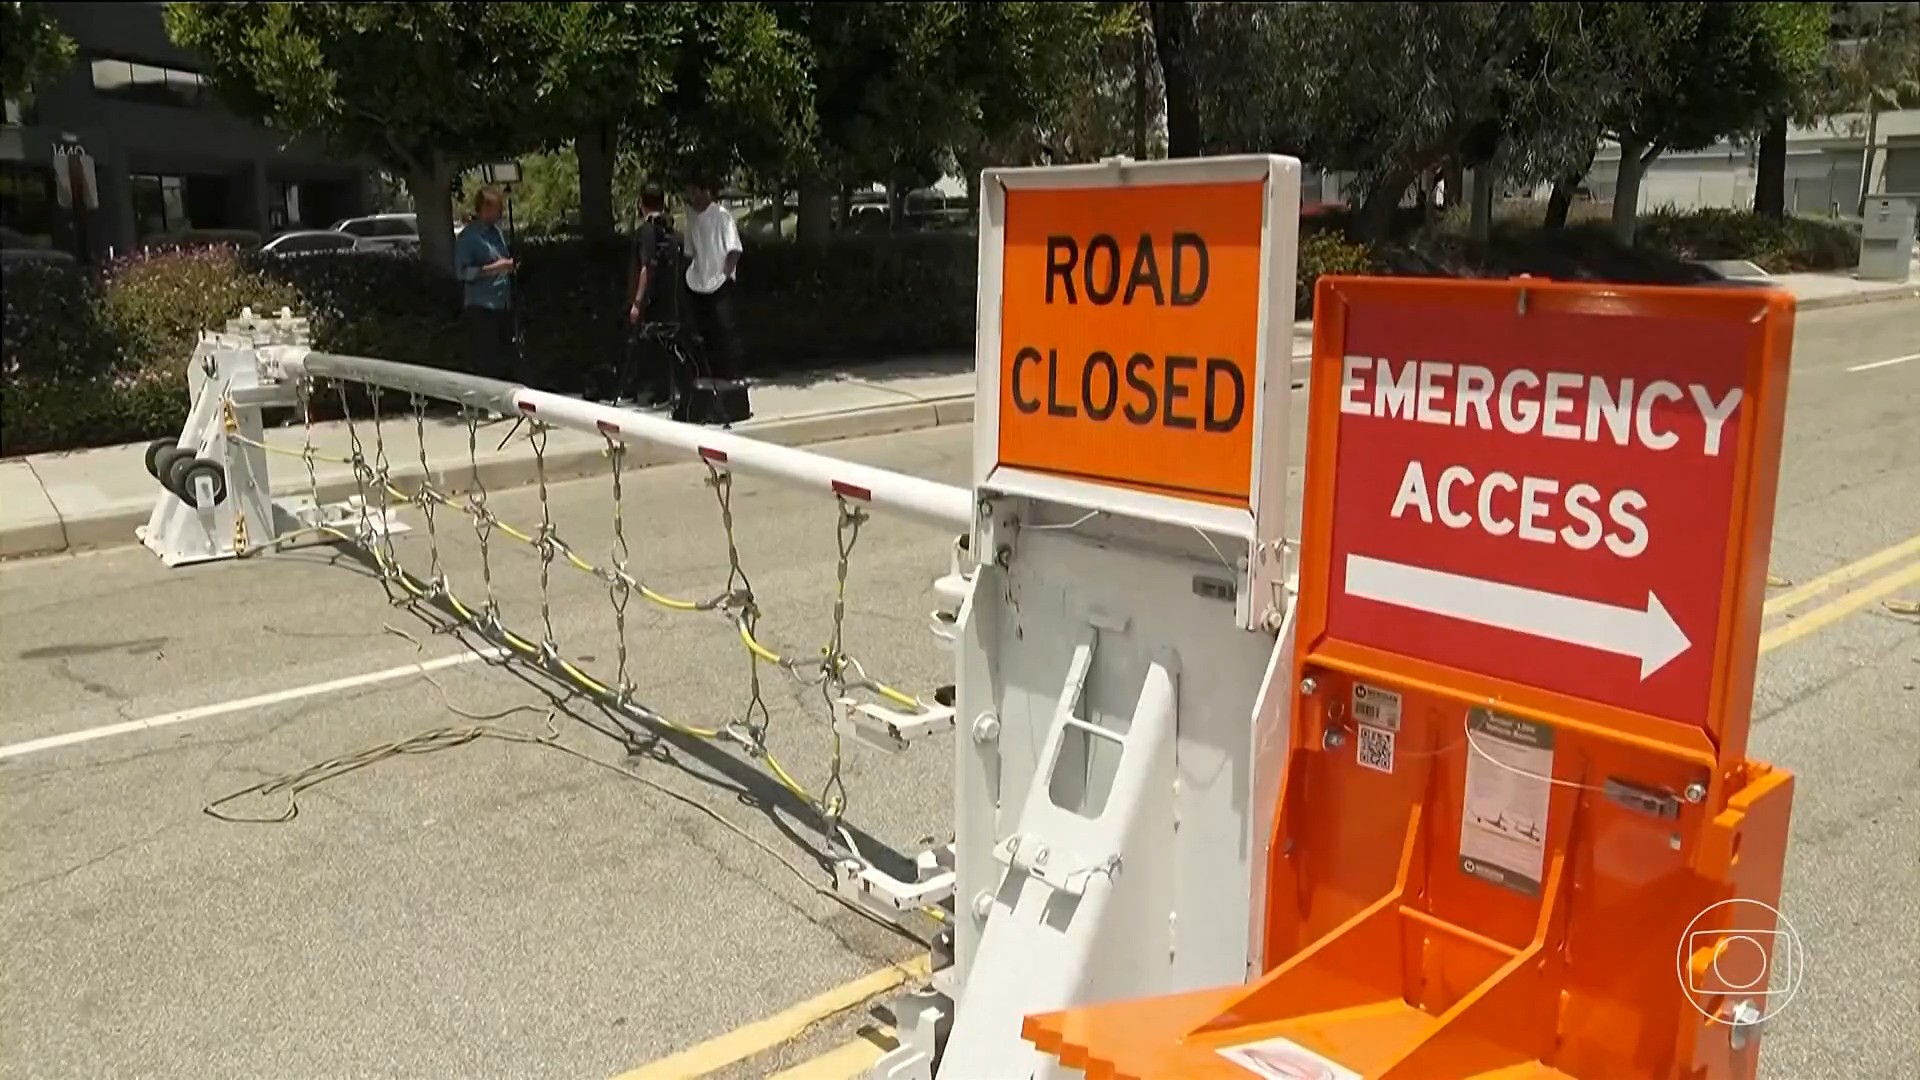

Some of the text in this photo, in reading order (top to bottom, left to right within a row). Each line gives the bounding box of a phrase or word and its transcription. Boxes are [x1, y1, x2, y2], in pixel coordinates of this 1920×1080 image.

[1045, 231, 1209, 307] ROAD
[1011, 346, 1245, 433] CLOSED
[1340, 355, 1743, 456] EMERGENCY
[1390, 460, 1650, 558] ACCESS
